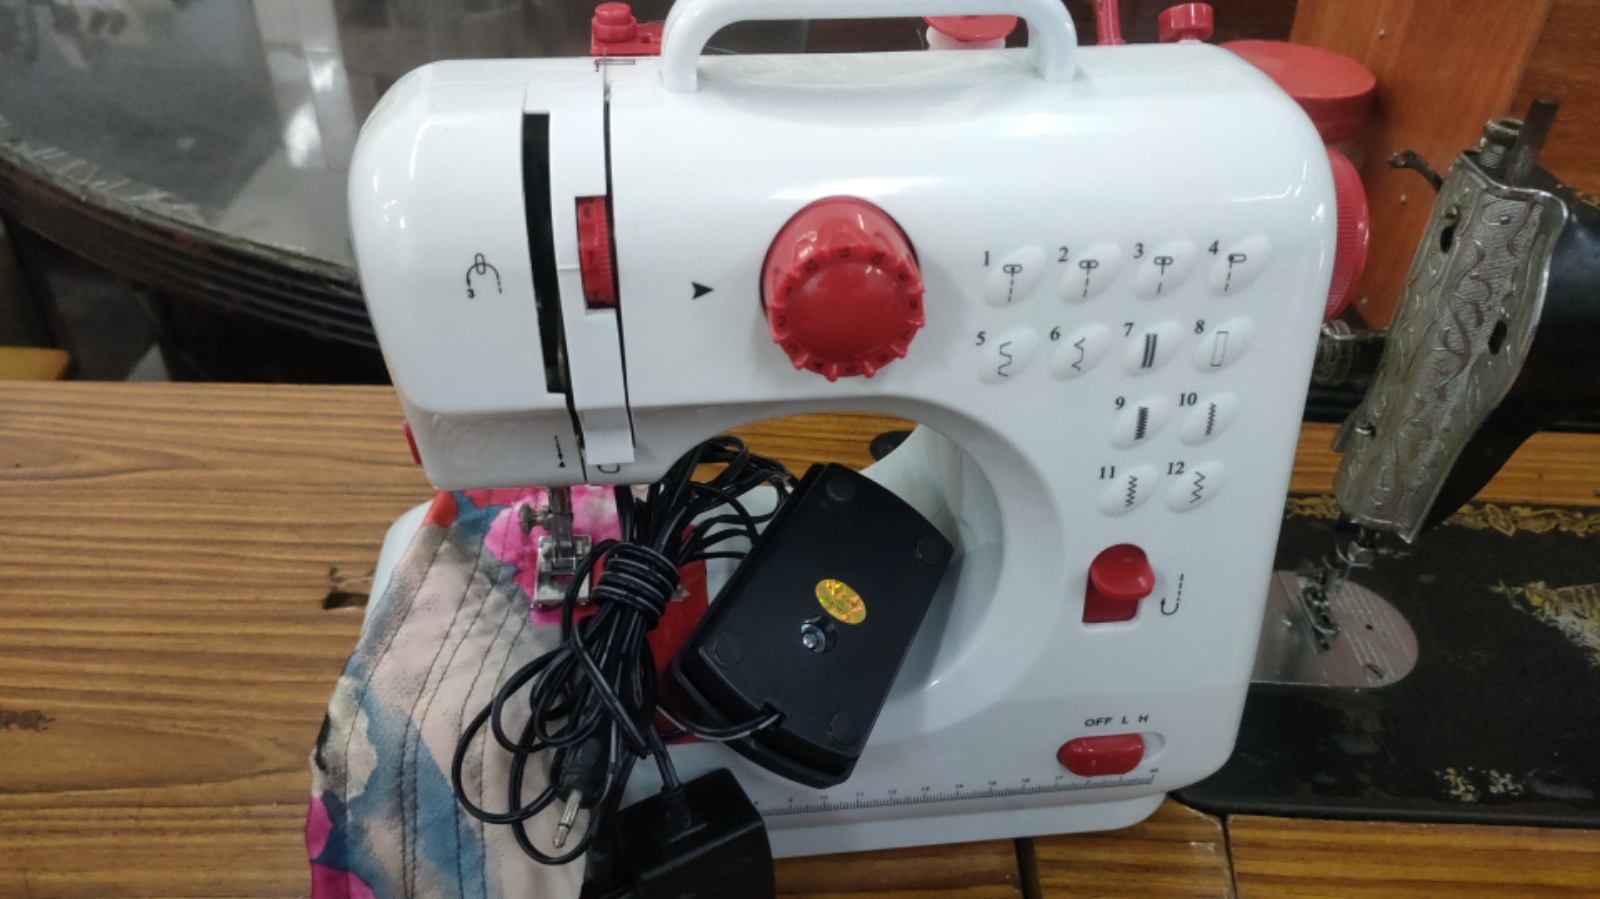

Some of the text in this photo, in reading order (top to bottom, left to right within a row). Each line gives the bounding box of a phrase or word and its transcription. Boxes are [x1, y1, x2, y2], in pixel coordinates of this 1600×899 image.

[983, 240, 1219, 267] 1 2 3 4
[976, 319, 1205, 346] 5 6 7 8
[1115, 392, 1198, 410] 9 10
[1099, 461, 1185, 479] 11 12
[1084, 714, 1149, 727] OFF L H
